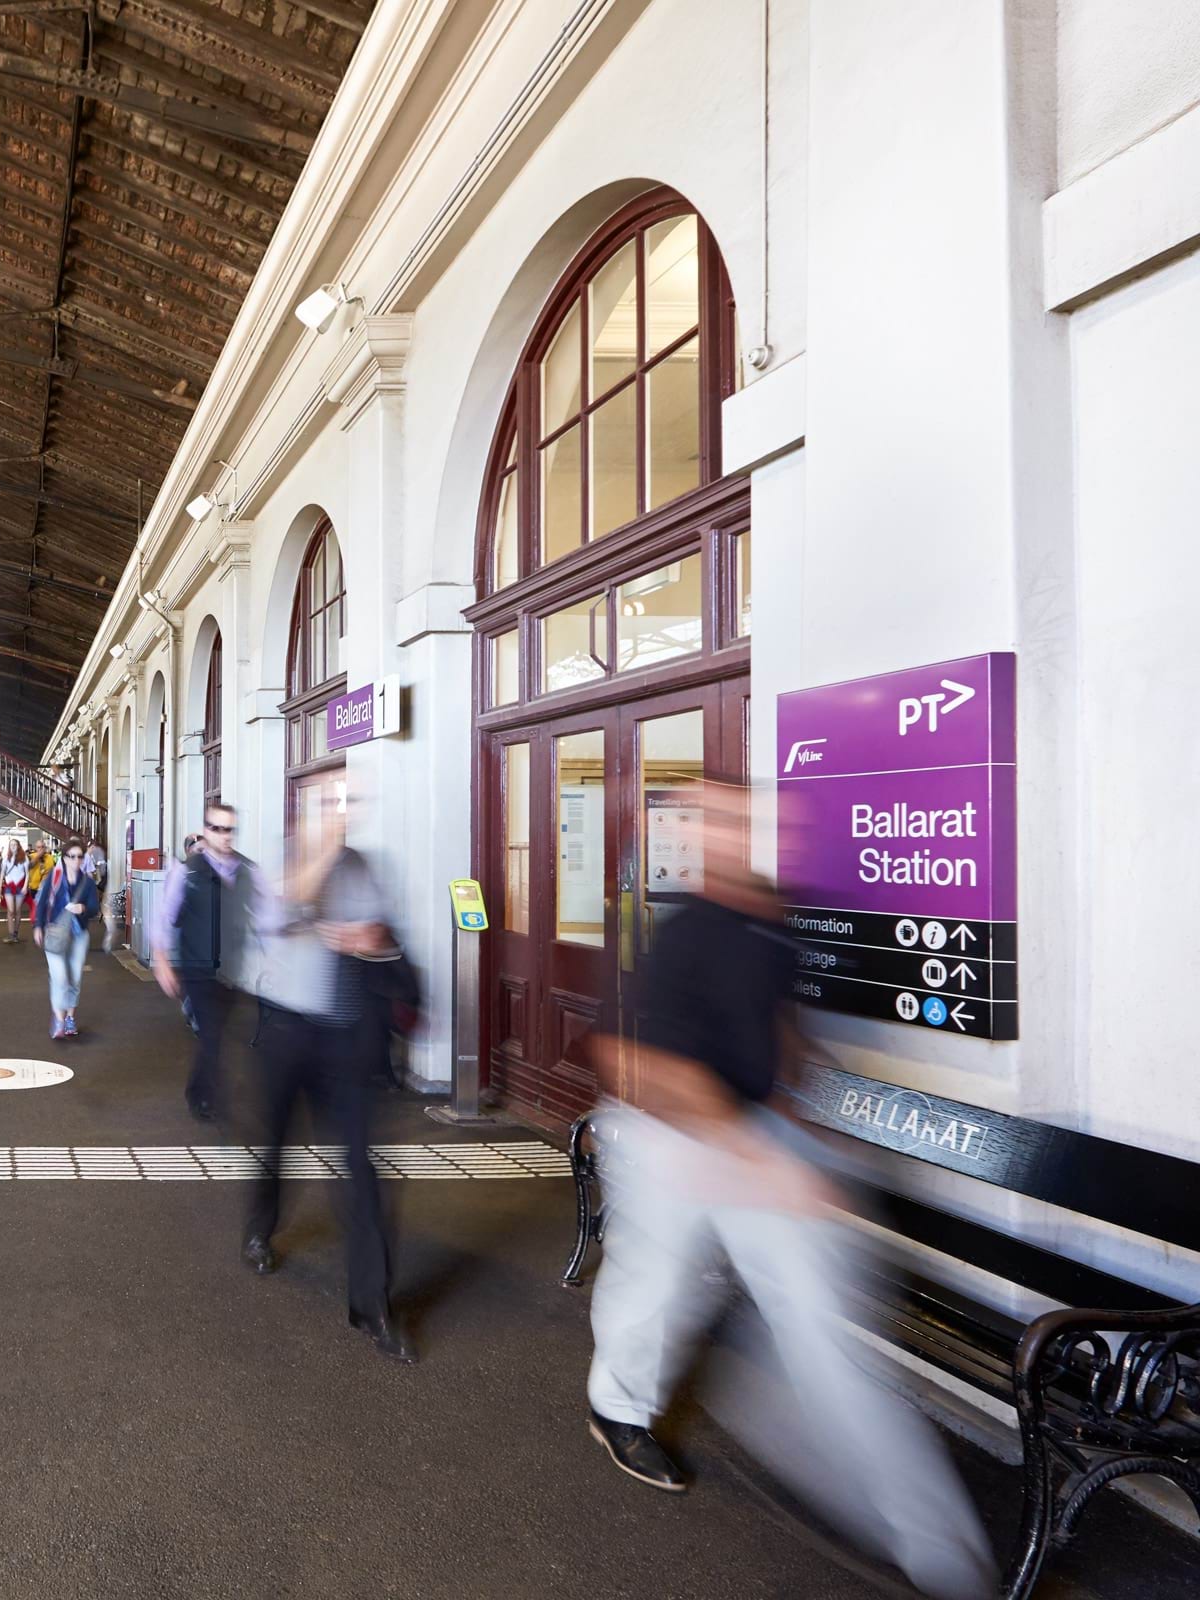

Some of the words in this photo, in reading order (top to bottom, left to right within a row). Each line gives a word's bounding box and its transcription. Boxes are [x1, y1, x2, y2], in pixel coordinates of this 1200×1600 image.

[336, 694, 373, 730] Ballarat
[378, 683, 386, 729] 1
[852, 802, 977, 837] Ballarat
[859, 848, 977, 886] Station
[784, 914, 853, 935] Information
[840, 1090, 980, 1153] BALLARAT
